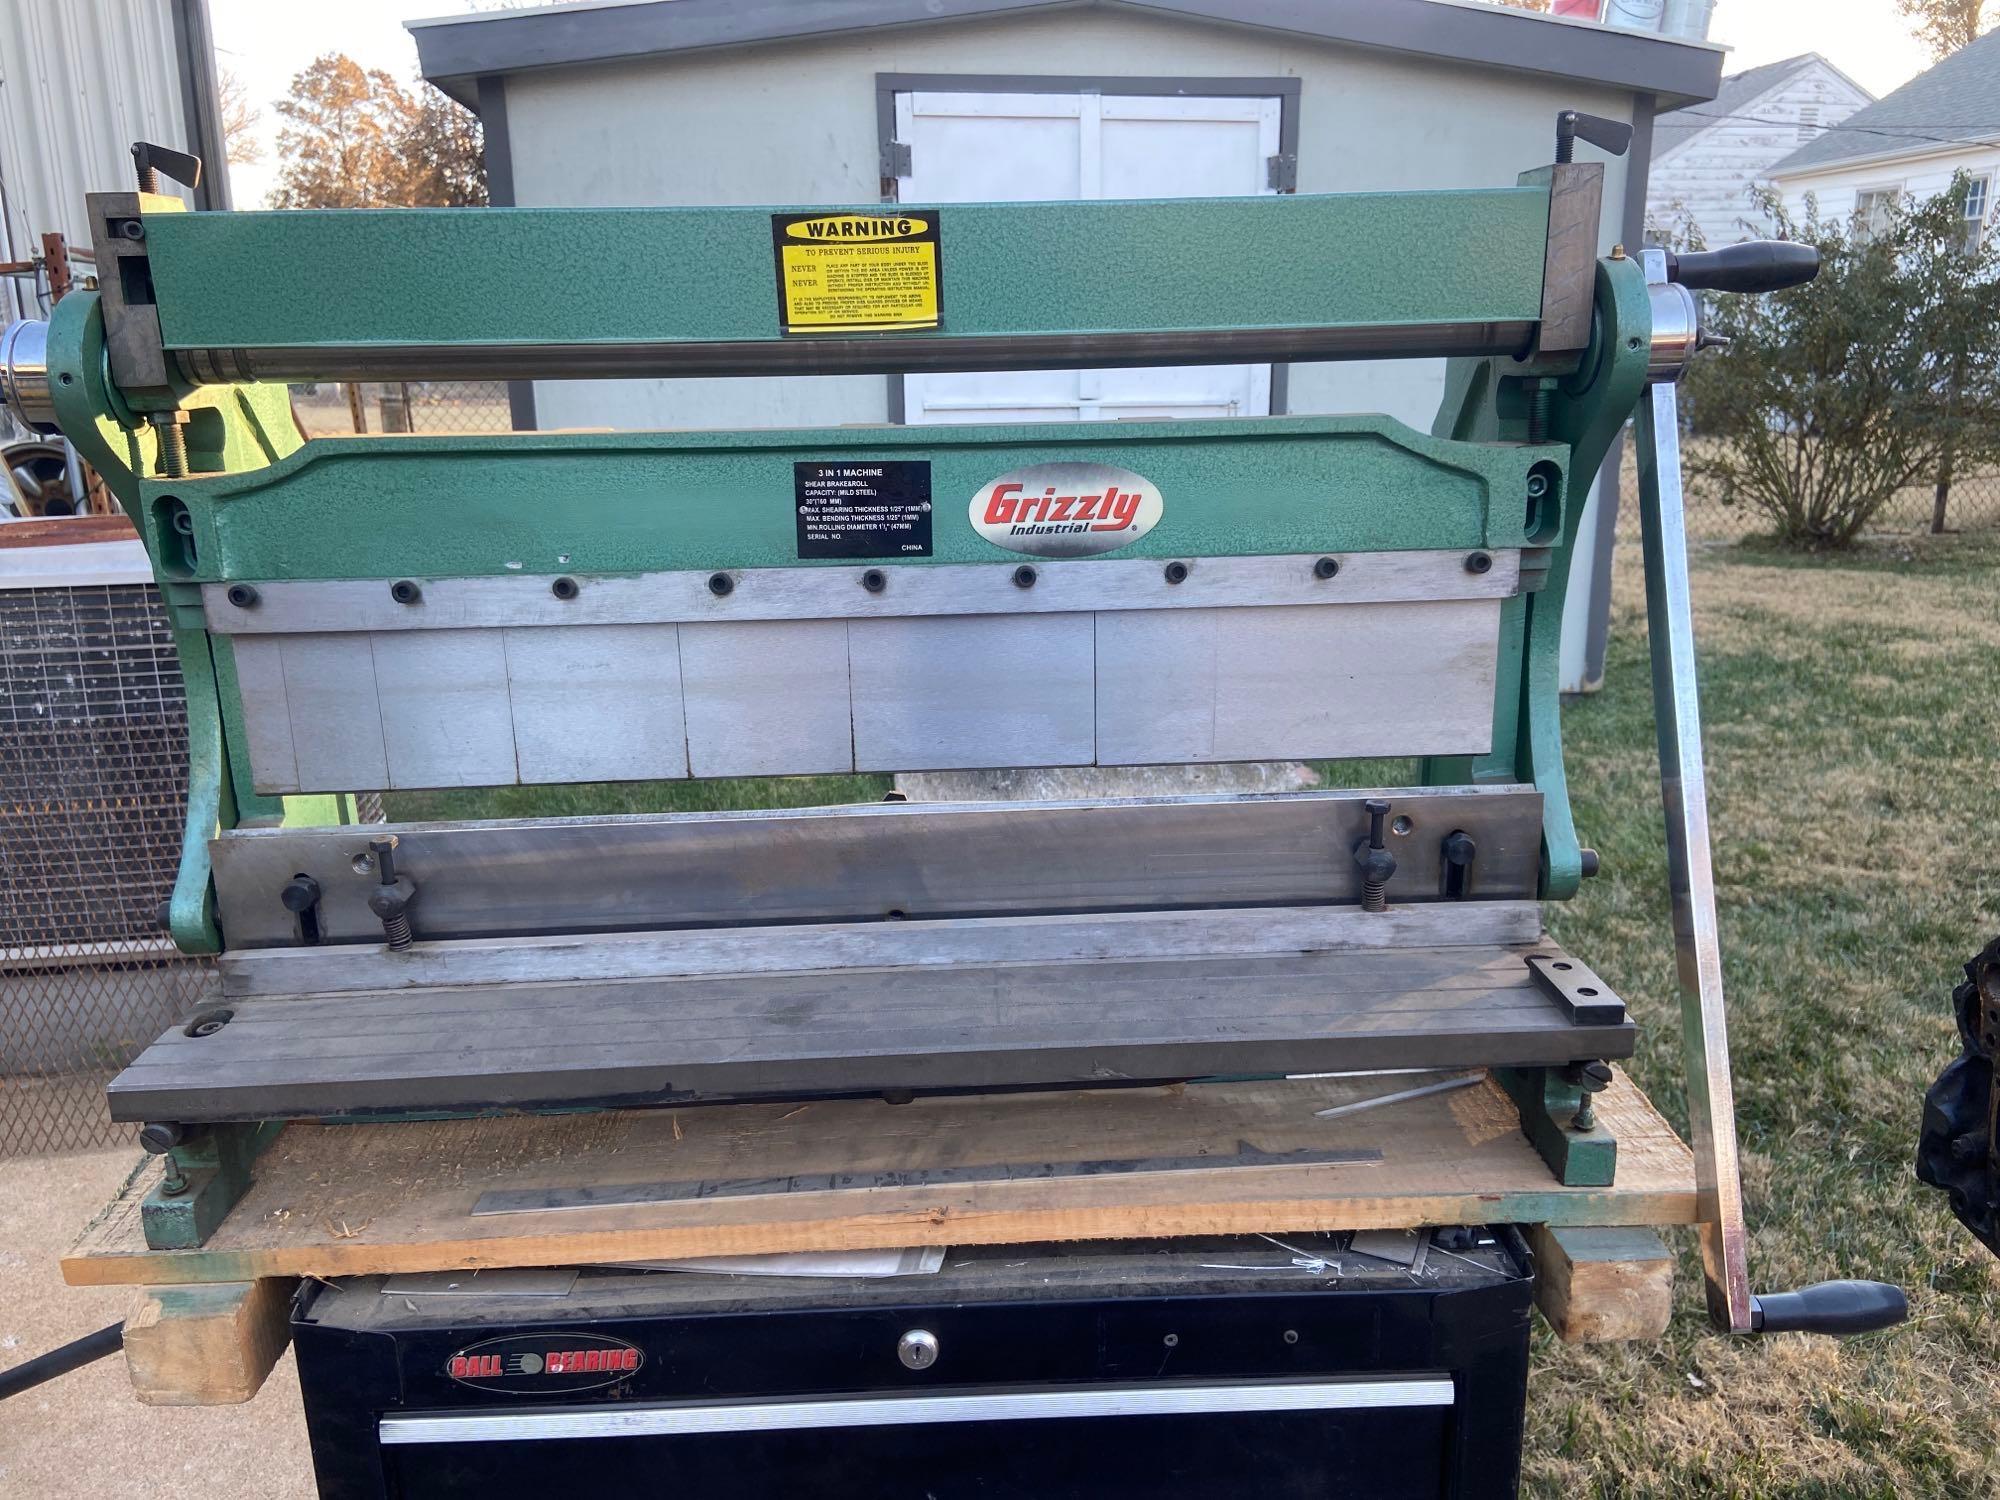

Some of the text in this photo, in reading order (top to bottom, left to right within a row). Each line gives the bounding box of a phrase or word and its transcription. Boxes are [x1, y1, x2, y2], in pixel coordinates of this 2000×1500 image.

[806, 220, 912, 238] WARNING
[984, 484, 1142, 532] Grizzly
[1010, 522, 1088, 535] Industrial
[452, 1348, 638, 1377] BALL BEARING
